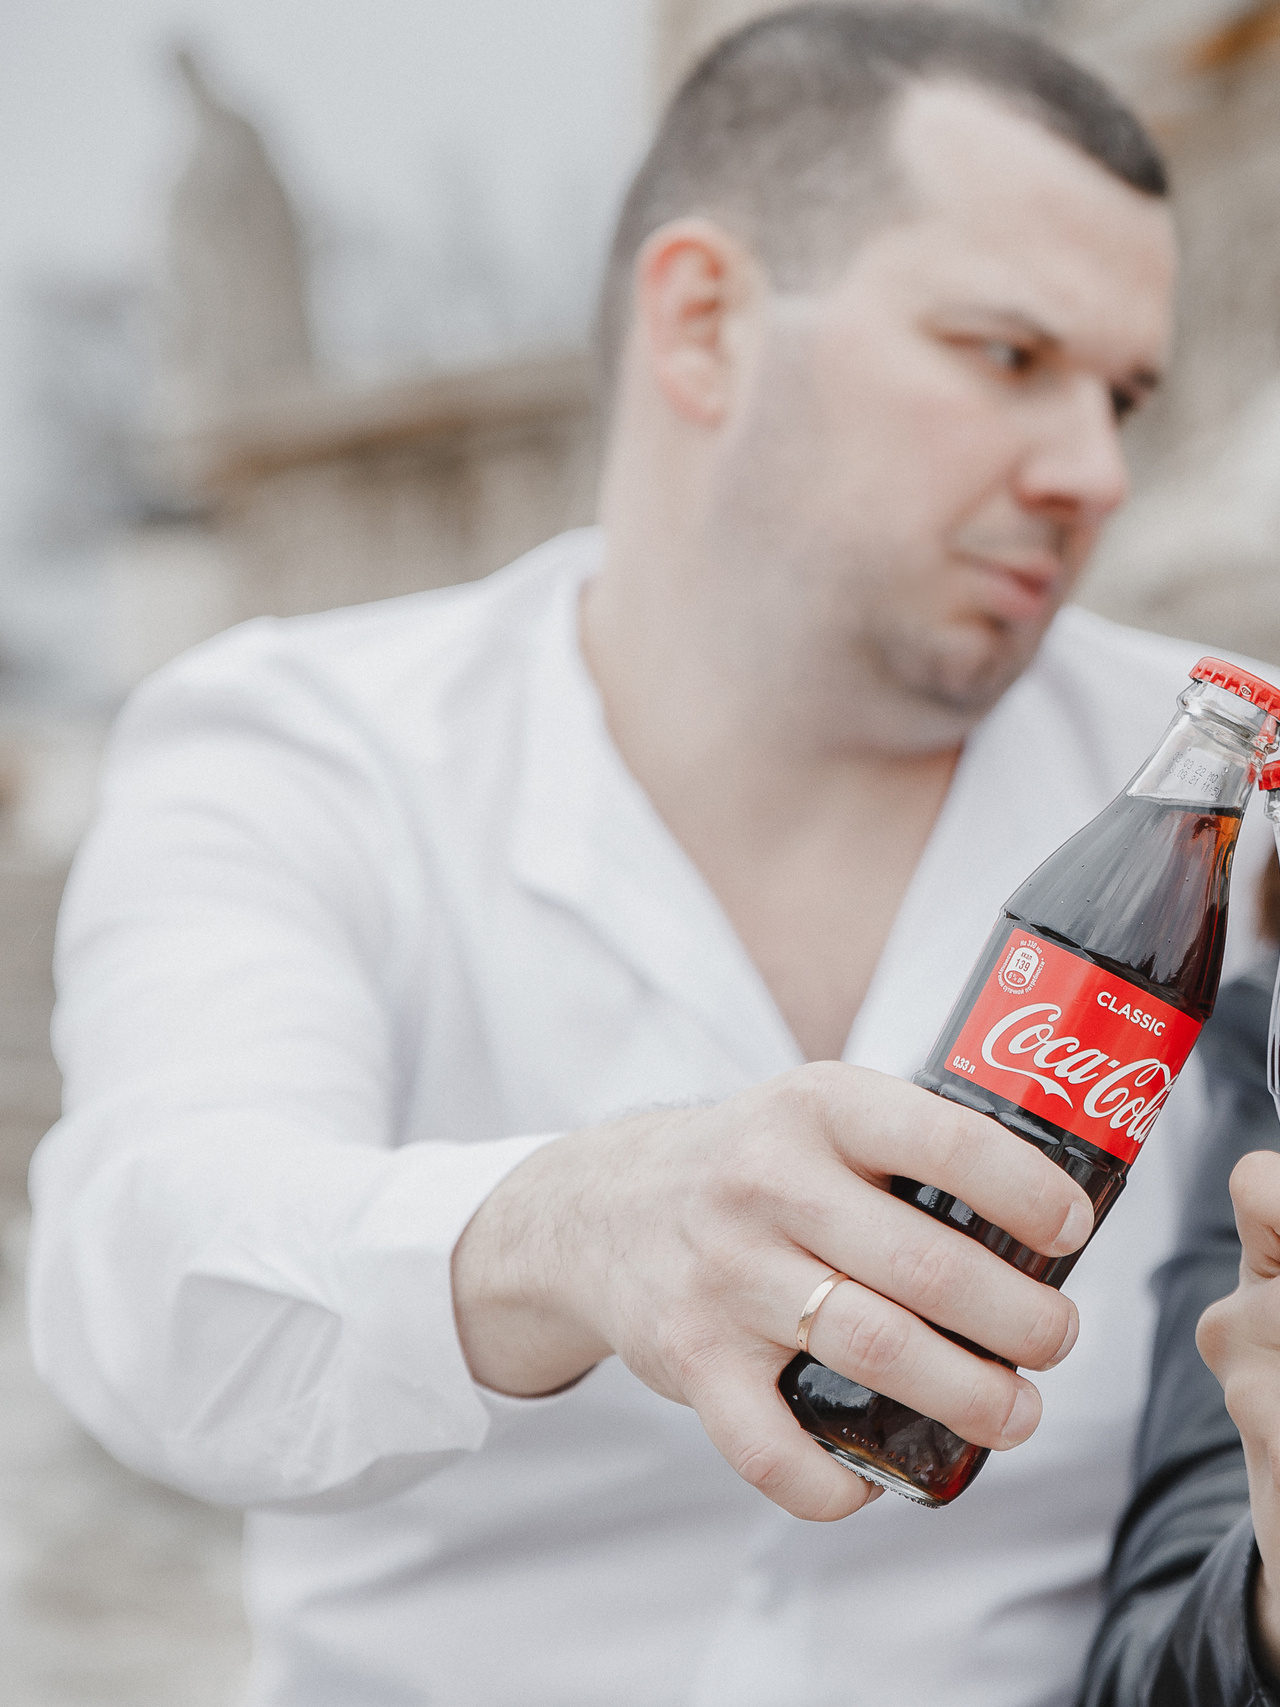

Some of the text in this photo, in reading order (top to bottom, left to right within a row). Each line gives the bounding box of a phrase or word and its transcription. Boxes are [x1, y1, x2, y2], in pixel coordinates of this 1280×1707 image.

[1027, 940, 1038, 949] 330
[1015, 958, 1031, 972] 139
[1097, 991, 1166, 1037] CLASSIC
[953, 1055, 976, 1075] 0,33 л
[981, 1002, 1179, 1144] Coca-Cola
